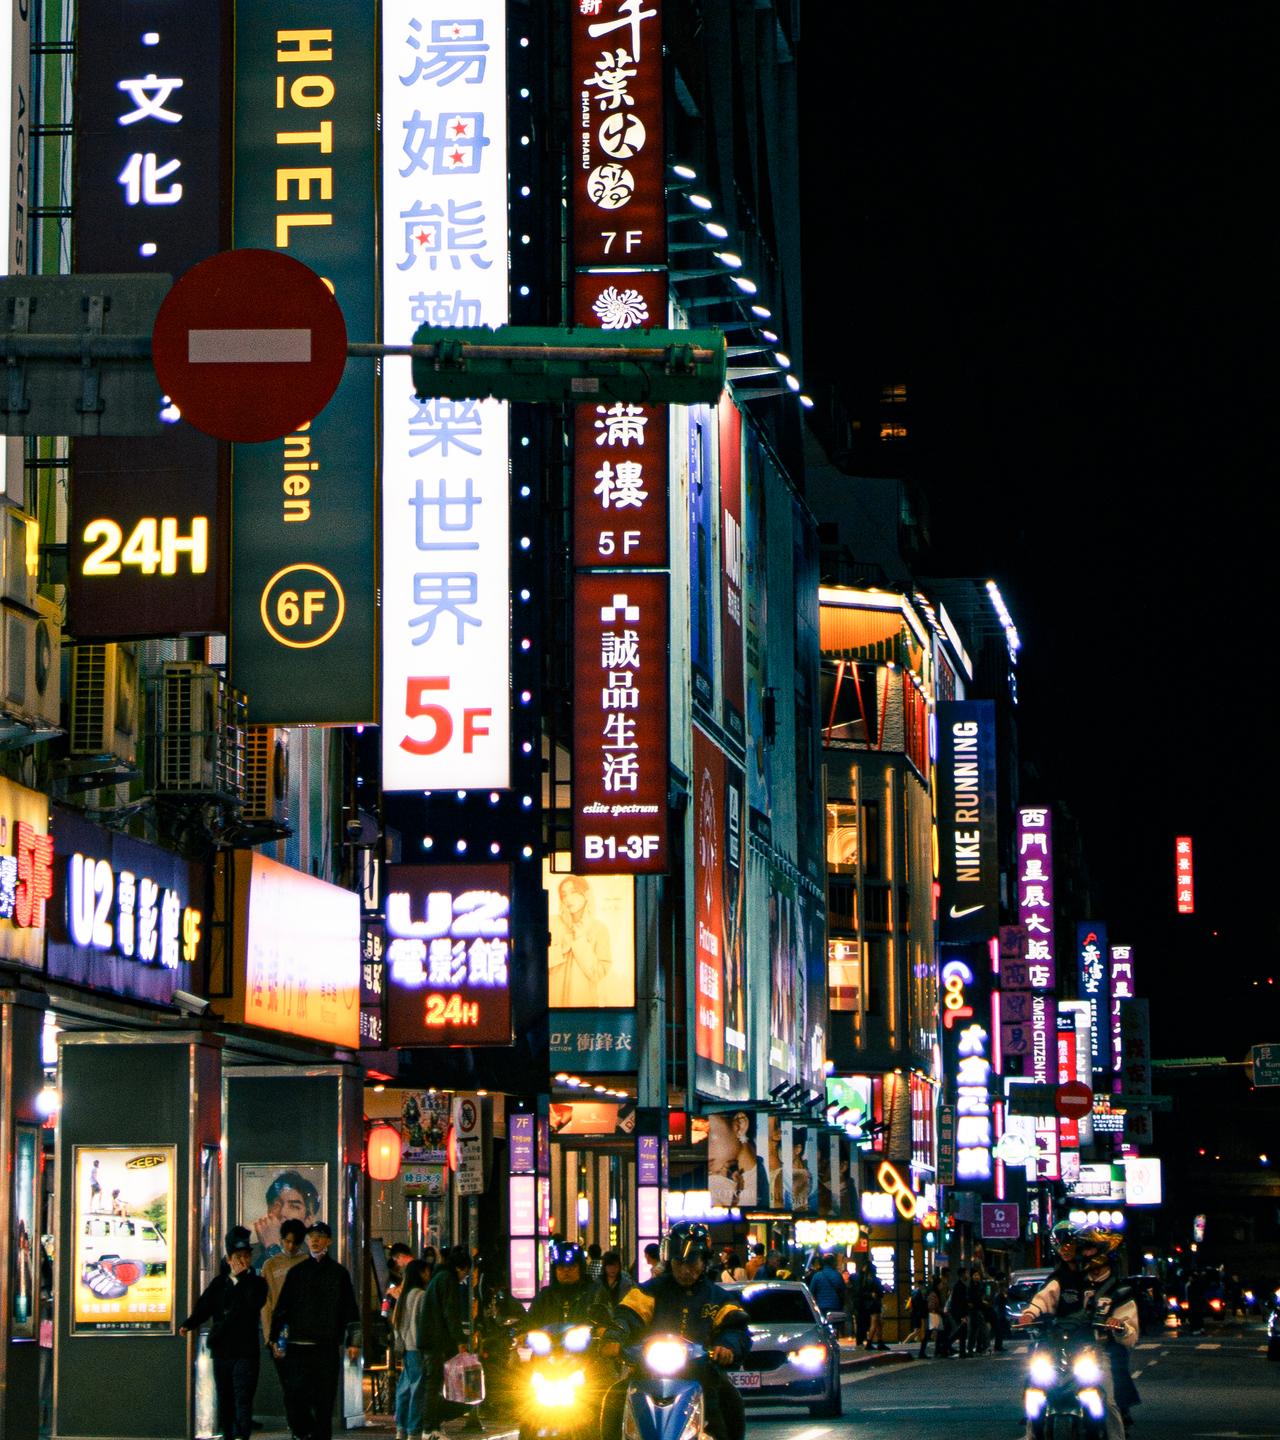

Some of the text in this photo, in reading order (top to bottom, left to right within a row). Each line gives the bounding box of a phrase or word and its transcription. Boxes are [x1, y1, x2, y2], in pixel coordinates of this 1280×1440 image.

[276, 29, 335, 247] HOTEL
[582, 90, 590, 169] SHABU SHABU
[283, 420, 319, 522] nien
[594, 403, 649, 509] 滿樓
[82, 517, 210, 576] 24H
[277, 590, 326, 625] 6F
[398, 676, 493, 756] 5F
[601, 630, 640, 792] 誠品生活
[583, 802, 658, 817] eslite spectrum
[953, 721, 981, 882] NIKE RUNNING
[585, 834, 659, 860] B1-3F
[71, 853, 201, 970] U2 電影館 9F
[387, 890, 509, 937] U2
[1020, 808, 1052, 988] 西門星辰大飯店
[387, 938, 509, 988] 電影館
[426, 995, 479, 1027] 24H
[1031, 996, 1045, 1030] XIMEN
[1032, 1031, 1046, 1073] CITIZEN
[127, 1154, 166, 1170] KEEN
